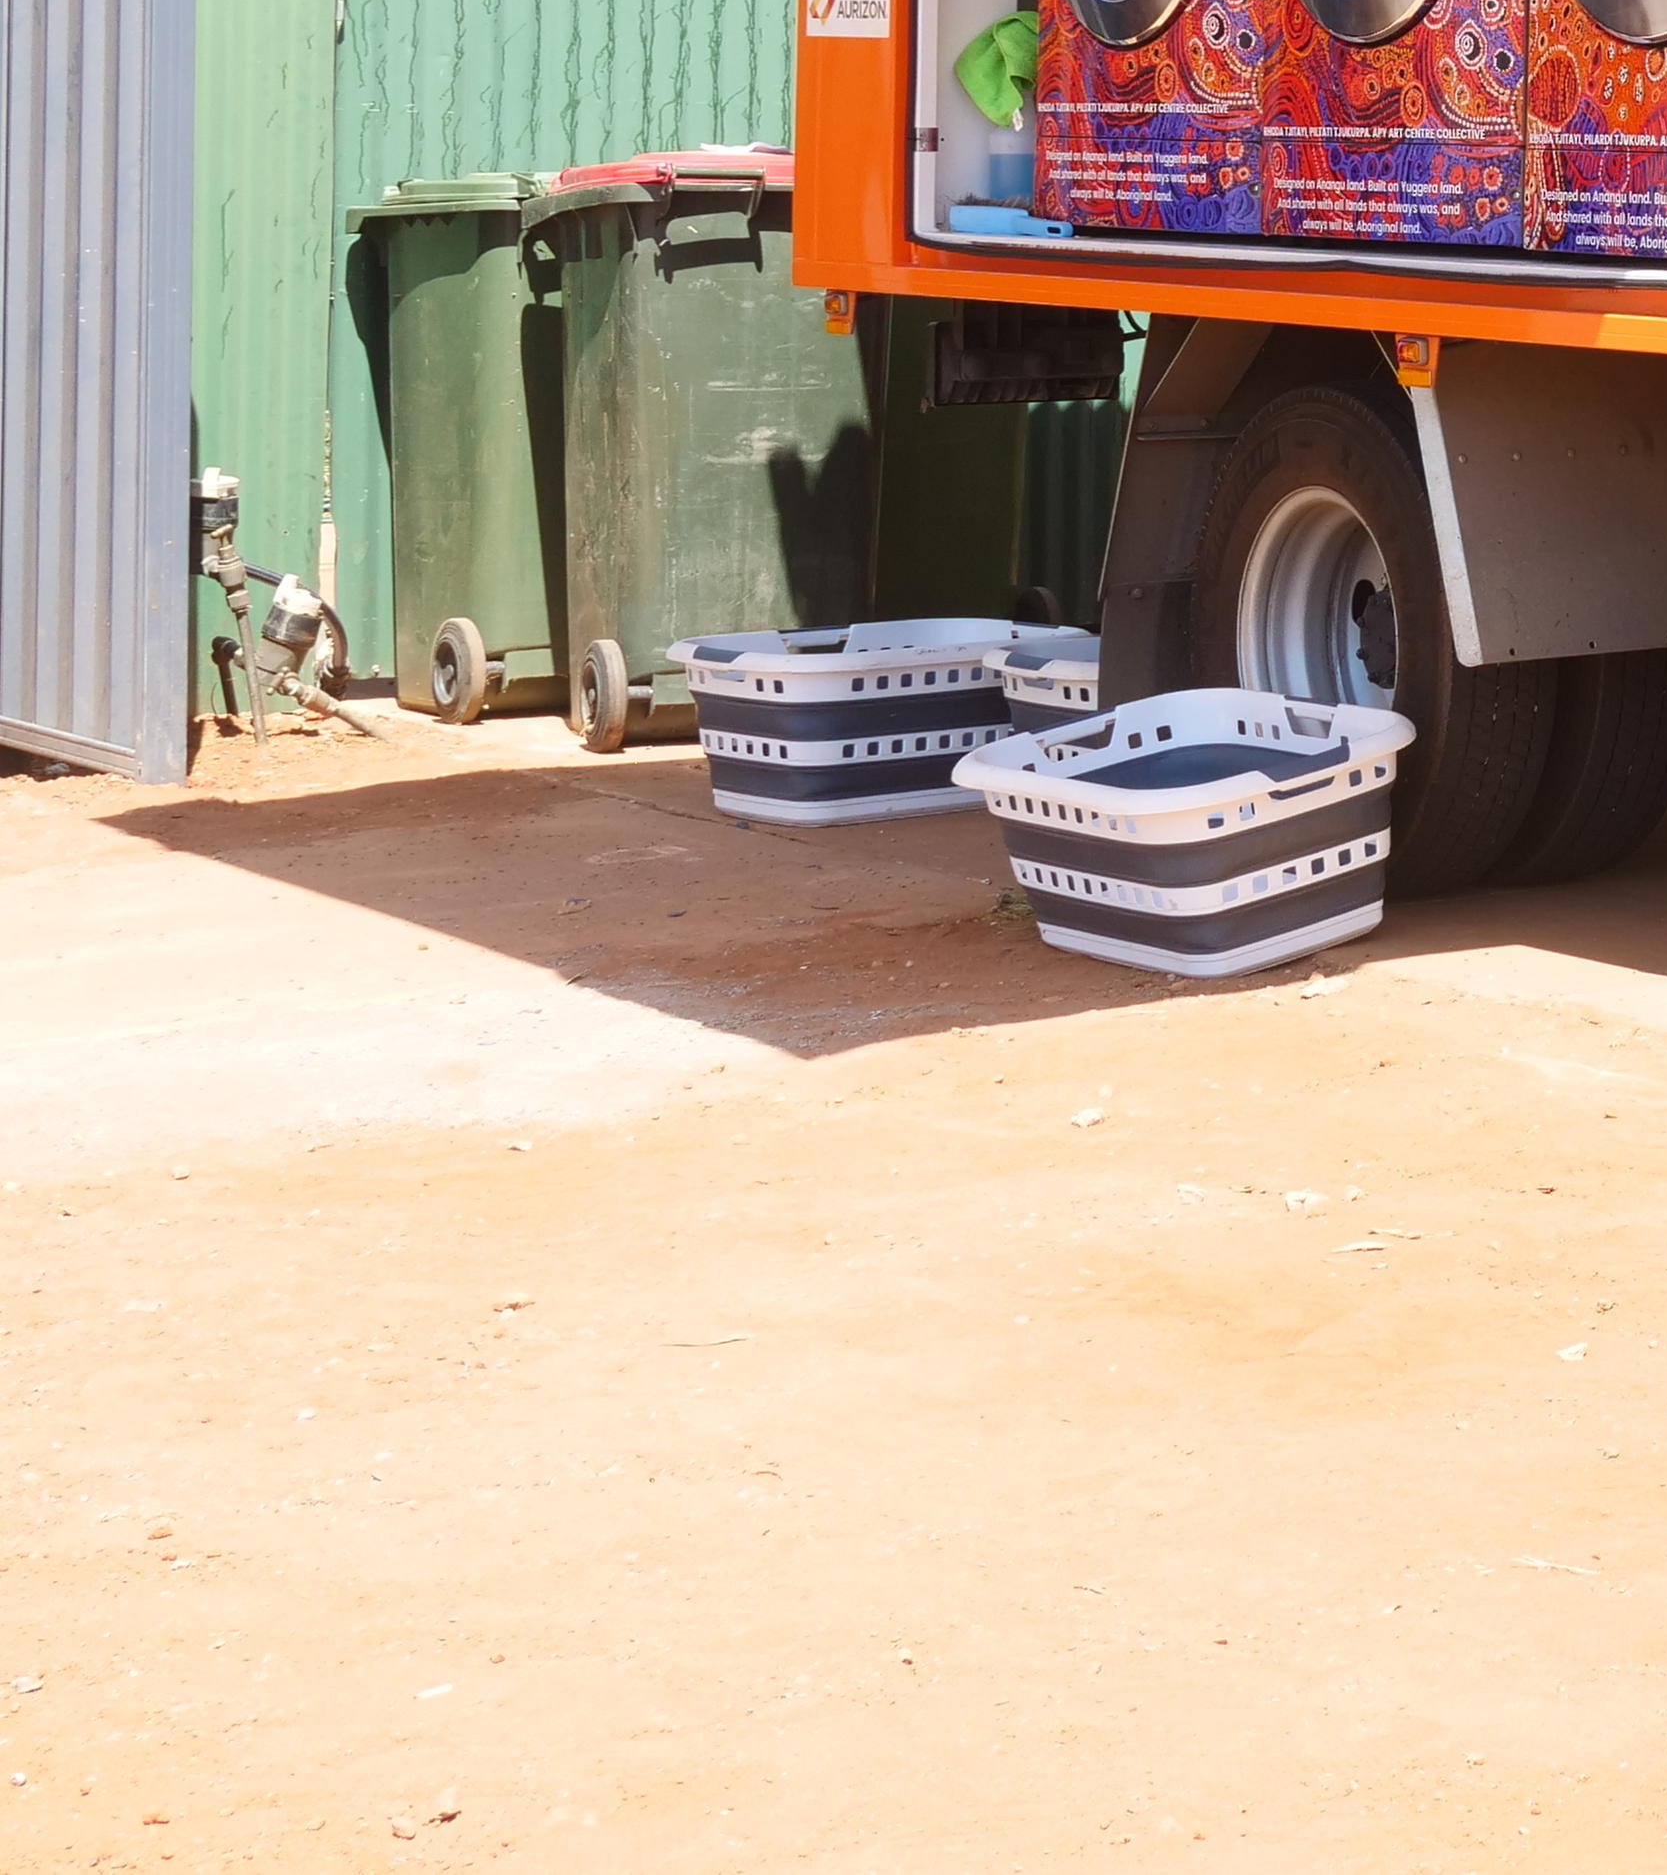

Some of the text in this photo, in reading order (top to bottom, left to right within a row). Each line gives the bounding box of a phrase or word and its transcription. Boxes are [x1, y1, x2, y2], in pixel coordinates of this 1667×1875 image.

[837, 1, 887, 19] AURIZON
[1372, 128, 1388, 138] APY
[1388, 128, 1404, 138] ART
[1405, 128, 1435, 139] CENTRE
[1436, 129, 1486, 140] COLLECTIVE
[1274, 177, 1305, 192] Designed
[1306, 181, 1315, 189] on
[1368, 180, 1386, 192] Built
[1388, 183, 1399, 192] on
[1401, 181, 1438, 197] Yuggera
[1541, 189, 1578, 205] Designed
[1580, 193, 1591, 202] on
[1629, 191, 1652, 204] land.
[1277, 197, 1291, 209] And
[1292, 198, 1316, 209] shared
[1317, 199, 1333, 210] with
[1334, 199, 1344, 211] all
[1345, 199, 1367, 212] lands
[1369, 200, 1387, 213] that
[1387, 200, 1418, 216] always
[1441, 203, 1460, 215] and
[1302, 218, 1327, 233] always
[1328, 218, 1343, 230] will
[1356, 220, 1398, 236] Aboriginal
[1546, 210, 1561, 222] And
[1563, 211, 1592, 224] shared
[1593, 211, 1612, 224] with
[1613, 211, 1625, 225] all
[1627, 212, 1653, 226] lands
[1575, 232, 1605, 249] always
[1605, 233, 1623, 247] will
[1624, 234, 1638, 250] be,
